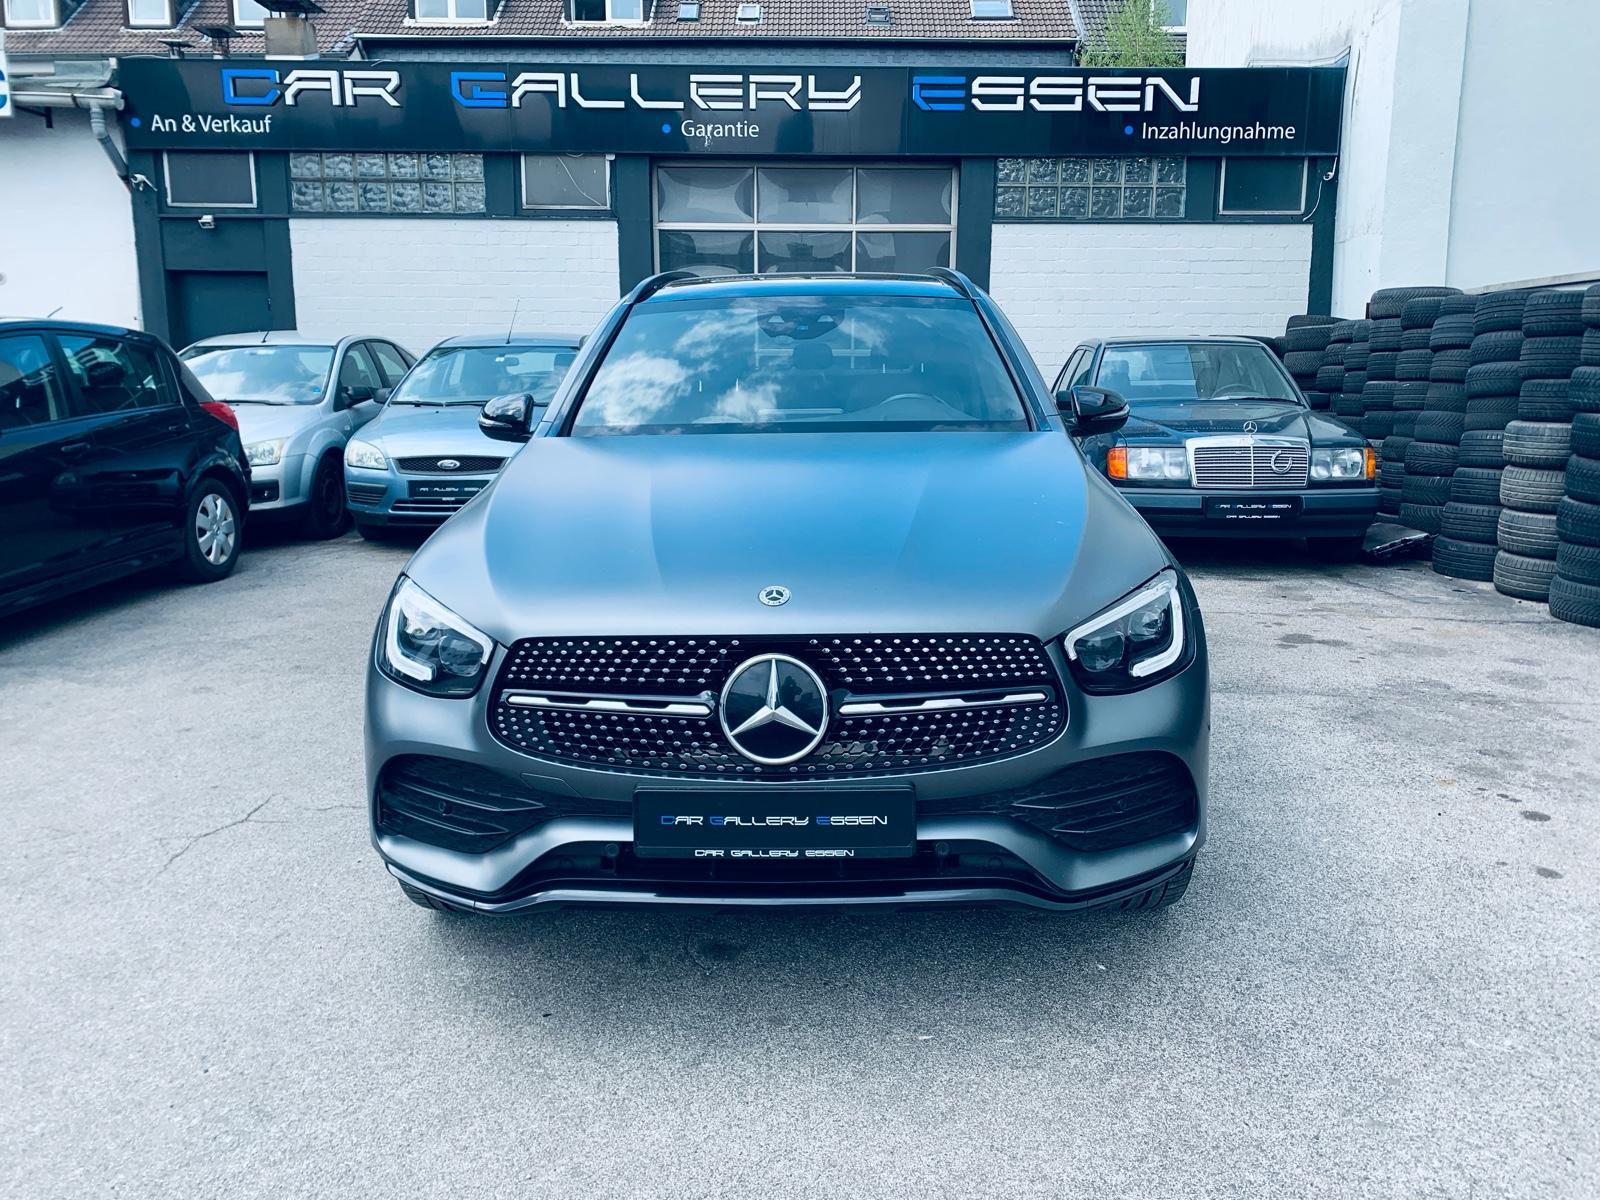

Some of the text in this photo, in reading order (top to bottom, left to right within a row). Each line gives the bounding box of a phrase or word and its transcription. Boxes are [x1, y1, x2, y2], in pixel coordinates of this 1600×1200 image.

[221, 68, 1200, 112] CAR GALLERY ESSEN
[151, 114, 272, 135] An & Verkauf
[680, 120, 760, 138] Garantie
[1141, 121, 1296, 144] Inzahlungnahme
[660, 815, 888, 826] CAR GALLERY ESSEN
[694, 849, 855, 858] CAR GALLERY ESSEN
